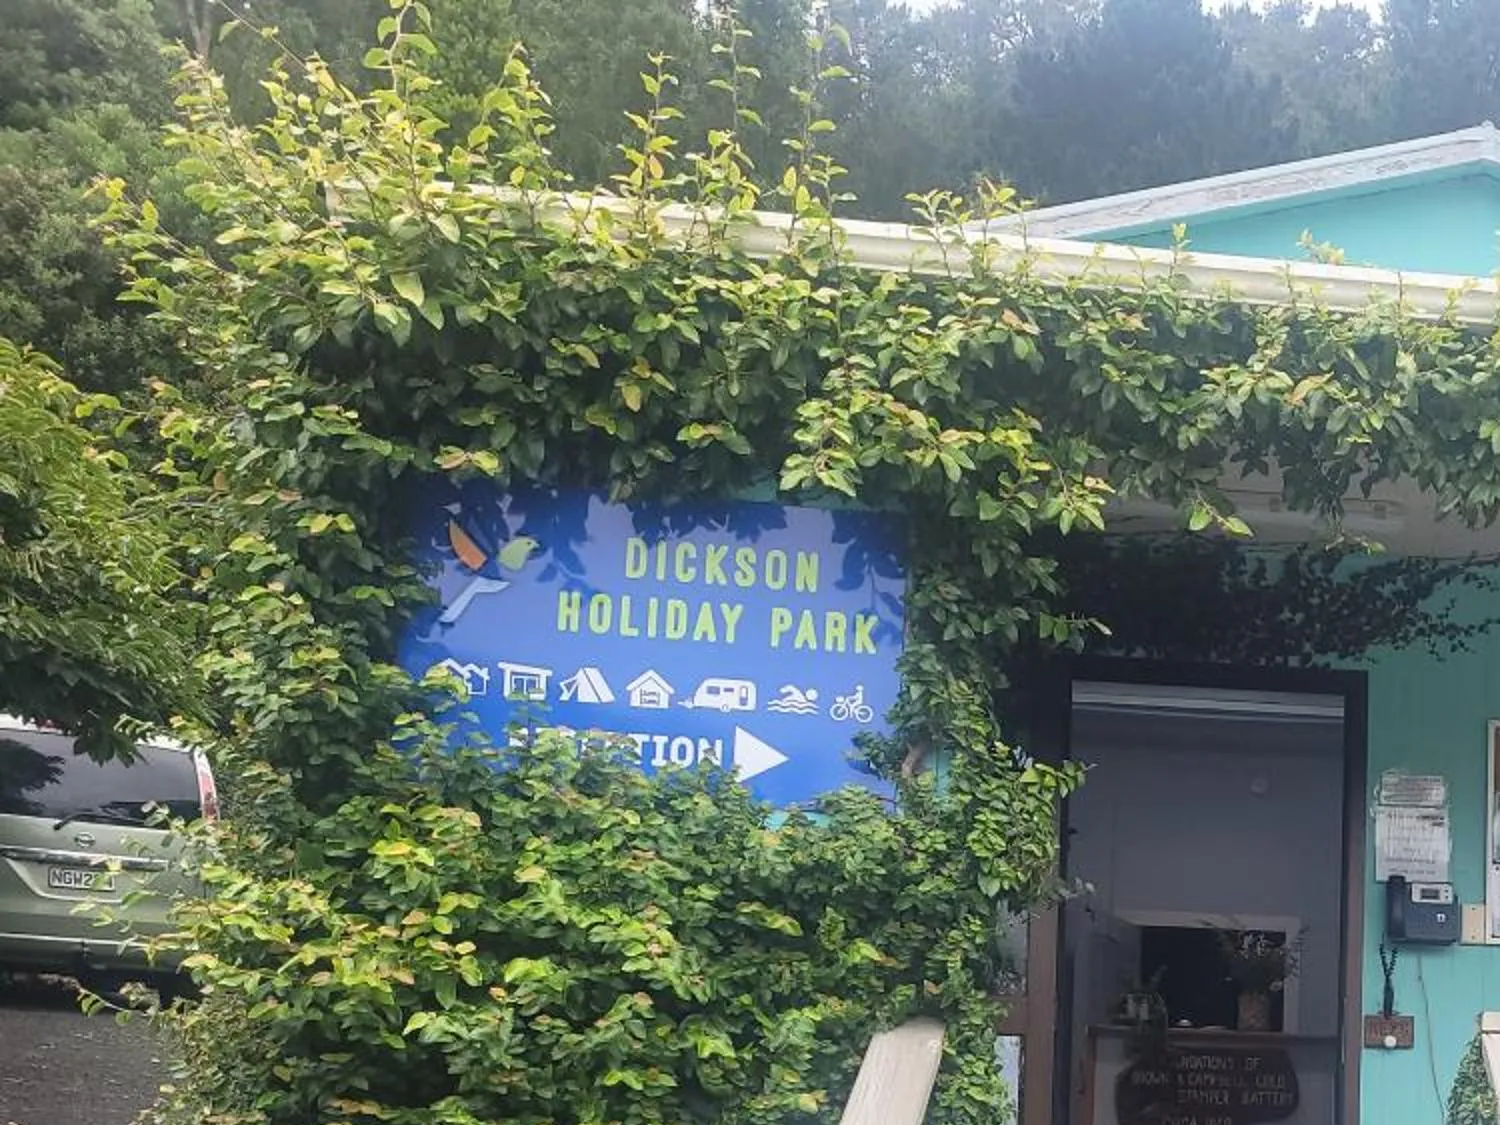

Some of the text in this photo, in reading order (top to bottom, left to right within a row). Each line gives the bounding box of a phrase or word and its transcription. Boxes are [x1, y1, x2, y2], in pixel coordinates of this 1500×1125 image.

[625, 537, 819, 593] DICKSON
[557, 591, 880, 655] HOLIDAY PARK
